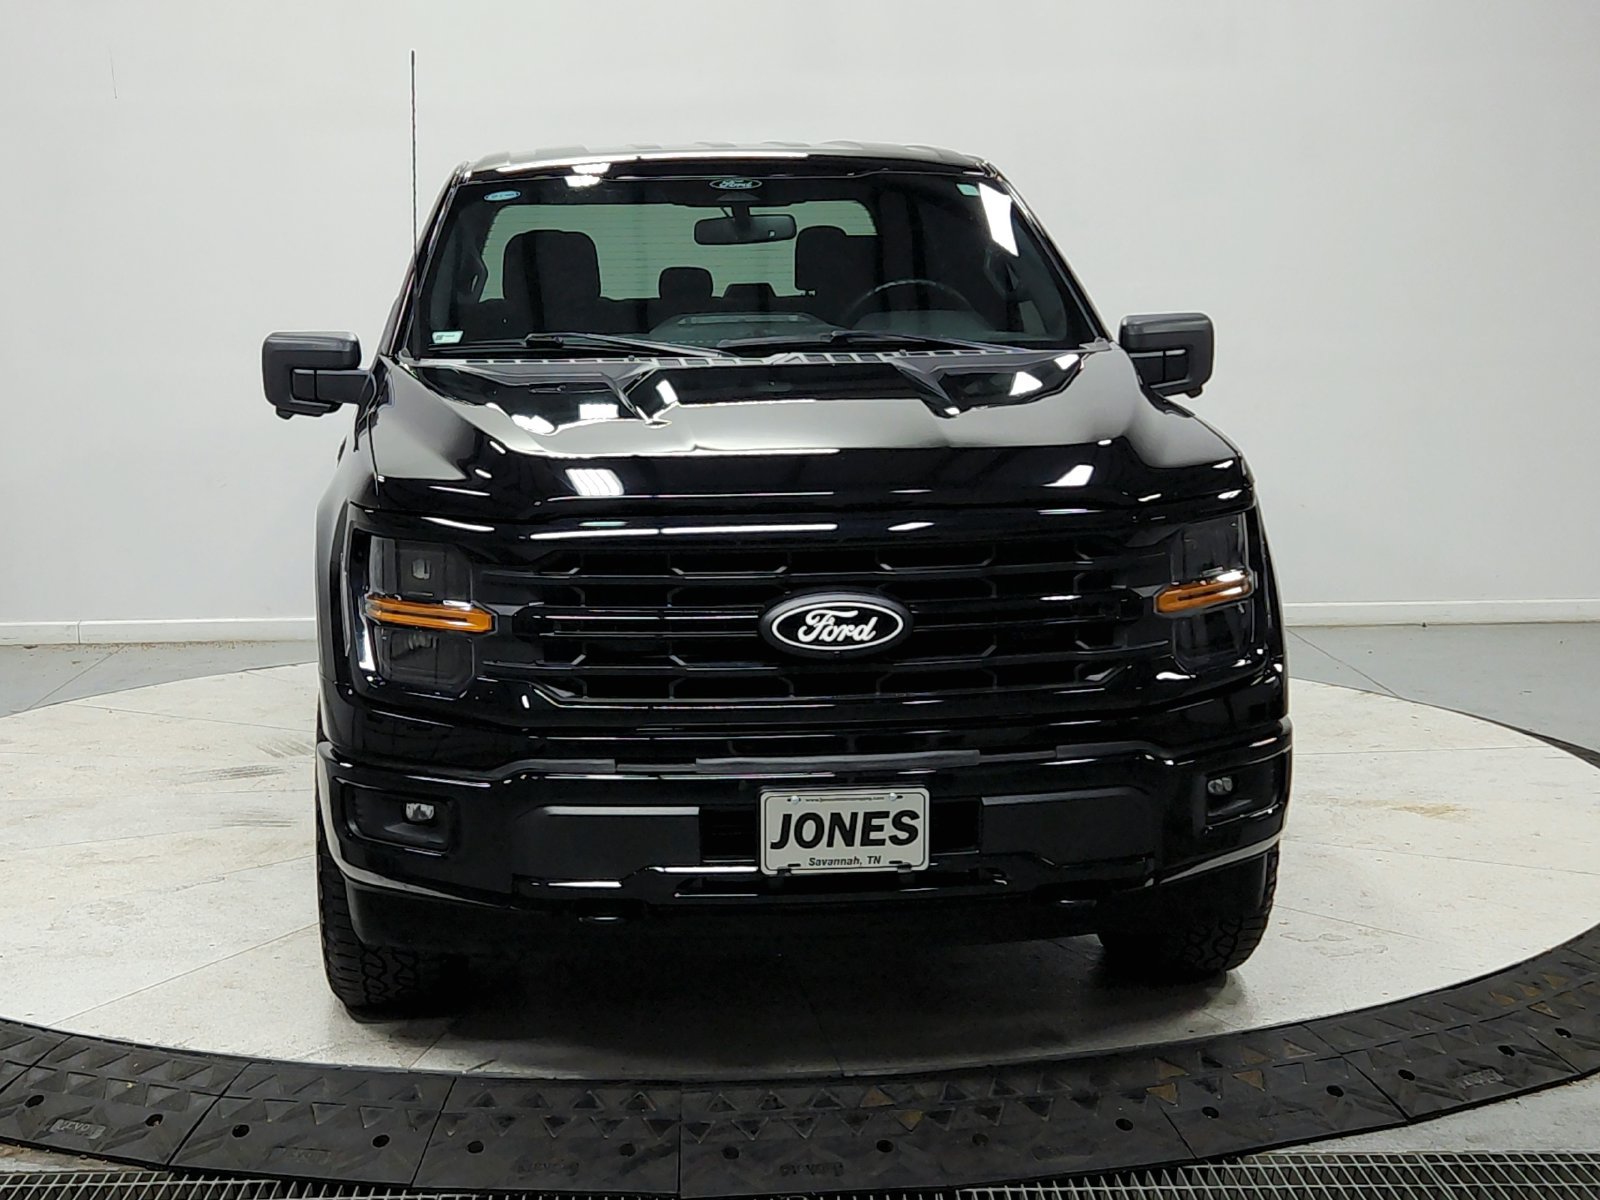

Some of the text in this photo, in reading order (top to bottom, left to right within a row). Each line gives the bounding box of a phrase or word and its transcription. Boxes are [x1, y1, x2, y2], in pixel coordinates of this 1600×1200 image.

[798, 609, 878, 642] Ford
[769, 809, 920, 850] JONES
[808, 855, 882, 867] Savannah, TN
